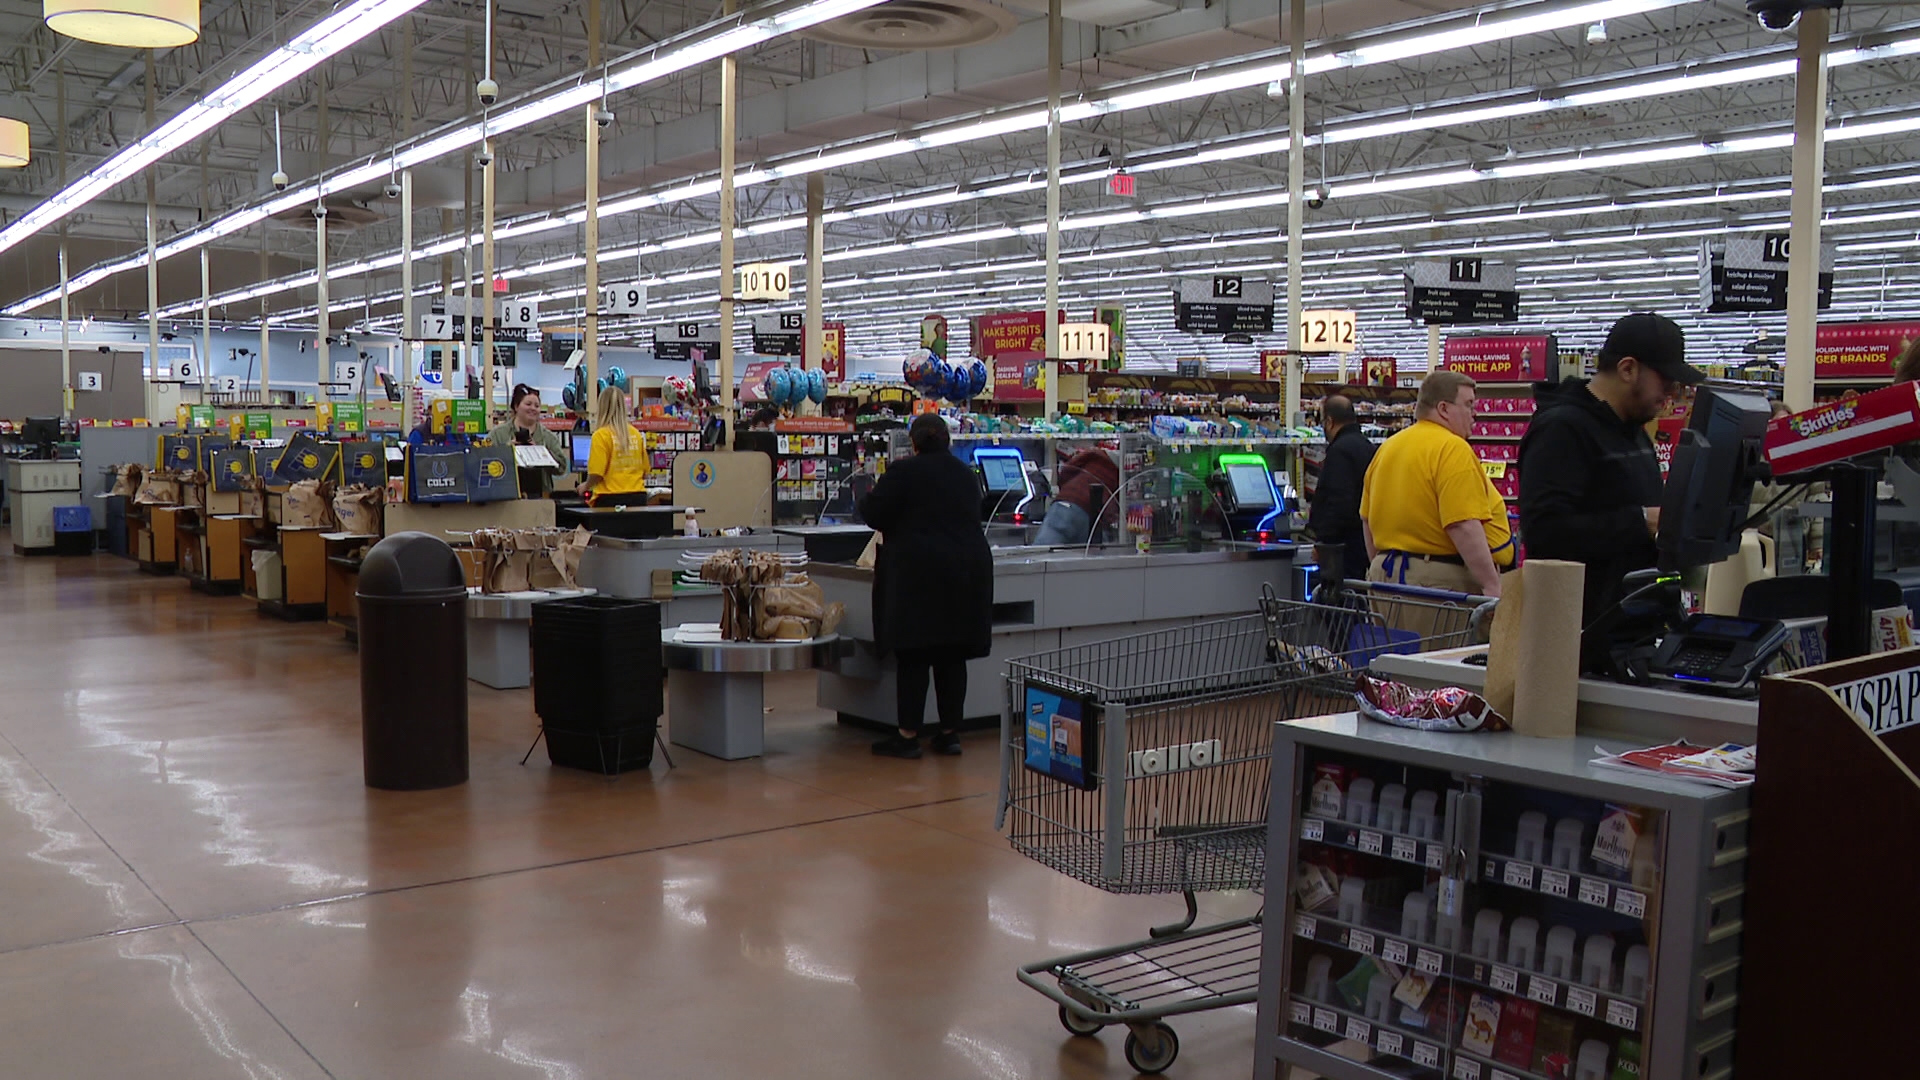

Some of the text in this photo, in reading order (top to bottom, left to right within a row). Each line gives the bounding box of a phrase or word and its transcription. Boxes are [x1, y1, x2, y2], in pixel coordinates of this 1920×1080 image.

[1114, 174, 1134, 195] EXIT
[1456, 260, 1477, 278] 11
[1726, 270, 1748, 280] ketchup
[744, 271, 758, 292] 10
[762, 272, 787, 292] 10
[1216, 279, 1240, 295] 12
[610, 290, 616, 308] 9
[627, 290, 639, 308] 9
[505, 306, 510, 322] 8
[520, 307, 530, 322] 8
[436, 320, 446, 334] 7
[782, 316, 800, 327] 15
[680, 324, 697, 336] 16
[983, 324, 1041, 338] MAKE SPIRITS
[1301, 320, 1327, 344] 12
[1332, 320, 1353, 344] 12
[995, 338, 1026, 350] BRIGHT
[1062, 331, 1081, 352] 11
[1087, 331, 1106, 352] 11
[1450, 354, 1482, 362] SEASONAL
[1840, 353, 1887, 363] BRANDS
[181, 364, 190, 376] 6
[347, 366, 356, 380] 5
[1450, 362, 1512, 372] ON THE APP
[88, 376, 96, 387] 3
[492, 370, 500, 382] 4
[227, 379, 234, 390] 2
[1799, 407, 1856, 437] Skittles
[427, 478, 456, 488] COLTS
[1618, 1058, 1640, 1073] KOO
